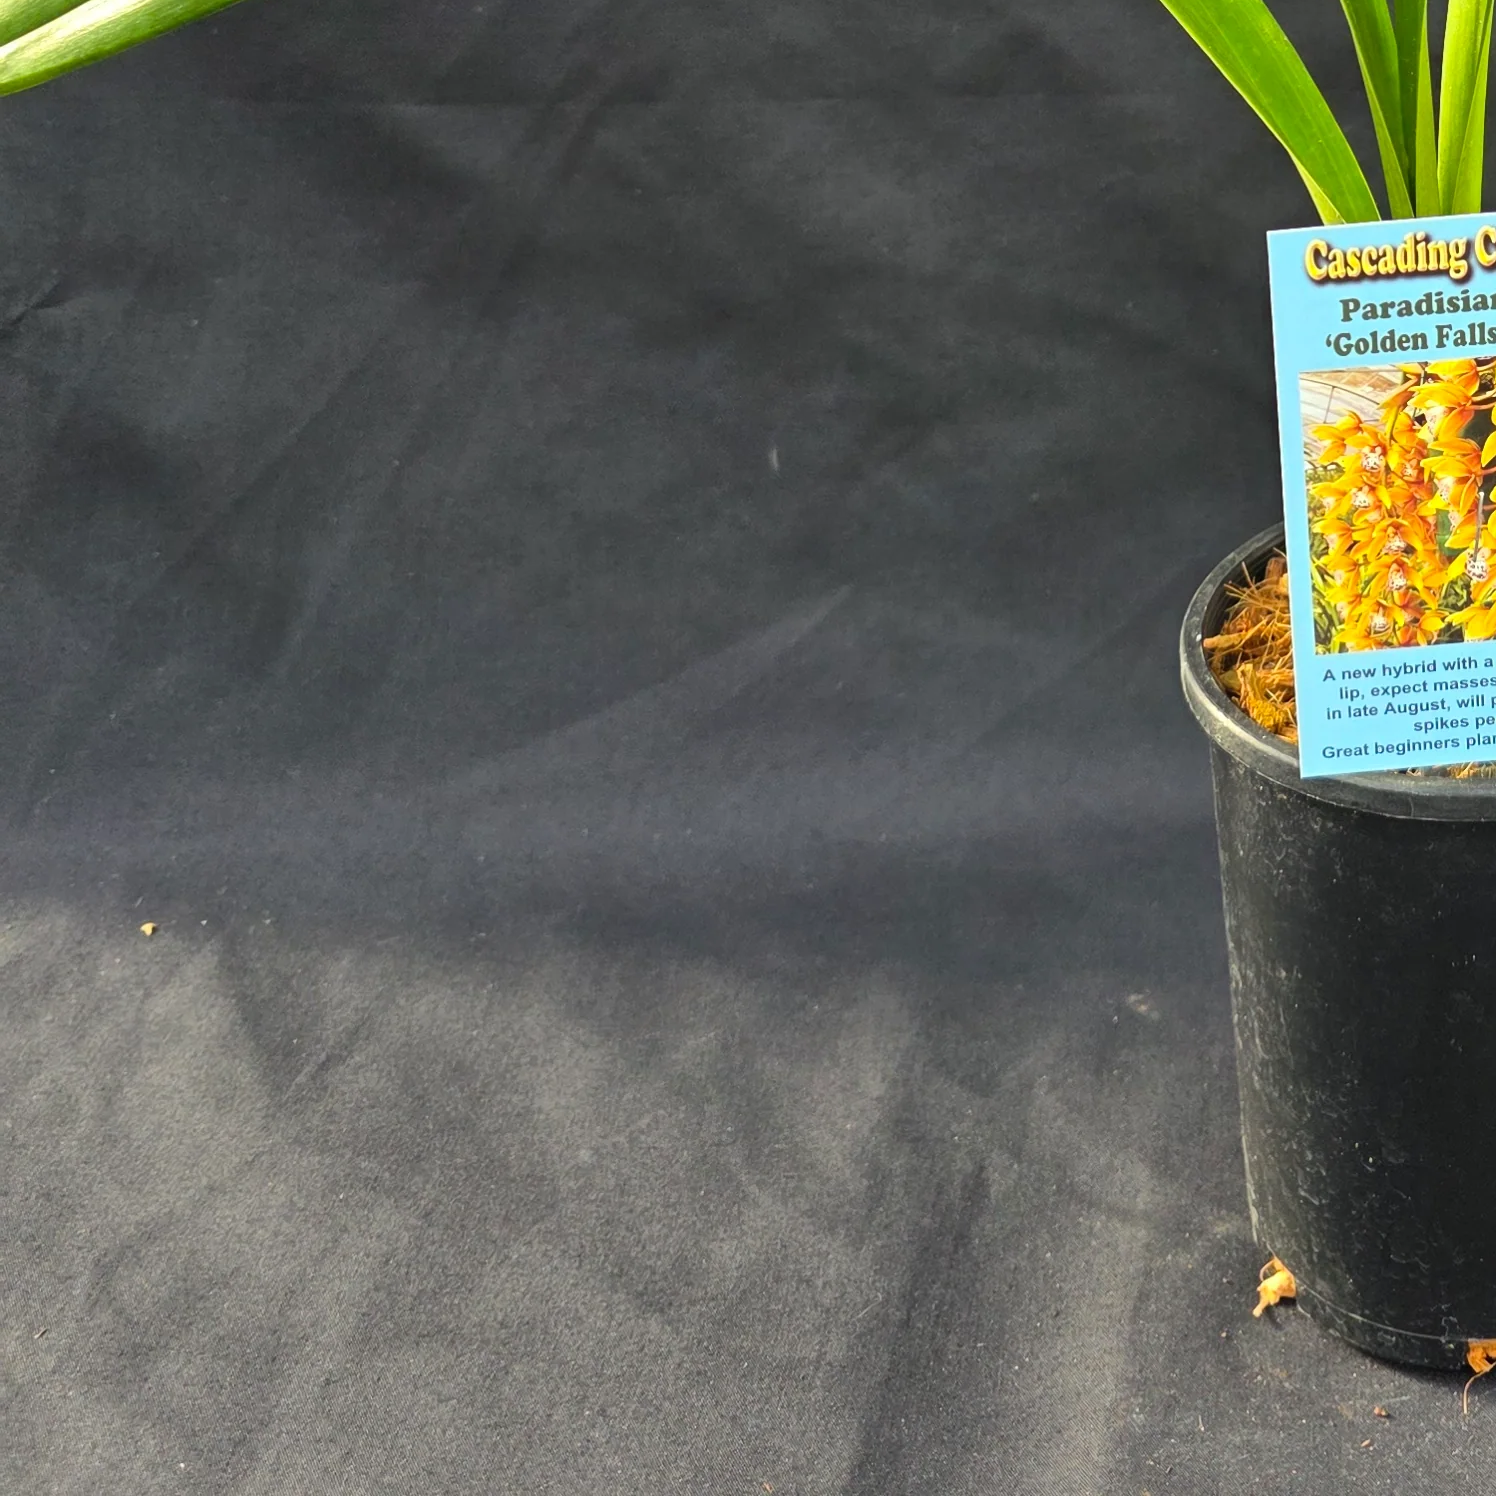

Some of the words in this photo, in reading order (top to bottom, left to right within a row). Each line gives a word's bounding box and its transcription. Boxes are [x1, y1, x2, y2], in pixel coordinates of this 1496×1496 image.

[1304, 231, 1467, 281] Cascading
[1322, 670, 1336, 682] A
[1342, 666, 1376, 680] new
[1382, 660, 1436, 678] hybrid
[1442, 656, 1478, 671] with
[1484, 657, 1493, 667] a
[1339, 686, 1365, 702] lip,
[1371, 680, 1428, 698] expect
[1327, 706, 1341, 719] in
[1348, 704, 1378, 718] late
[1384, 698, 1451, 716] August,
[1456, 695, 1485, 709] will
[1414, 716, 1469, 734] spikes
[1322, 744, 1369, 759] Great
[1375, 735, 1460, 756] beginners
